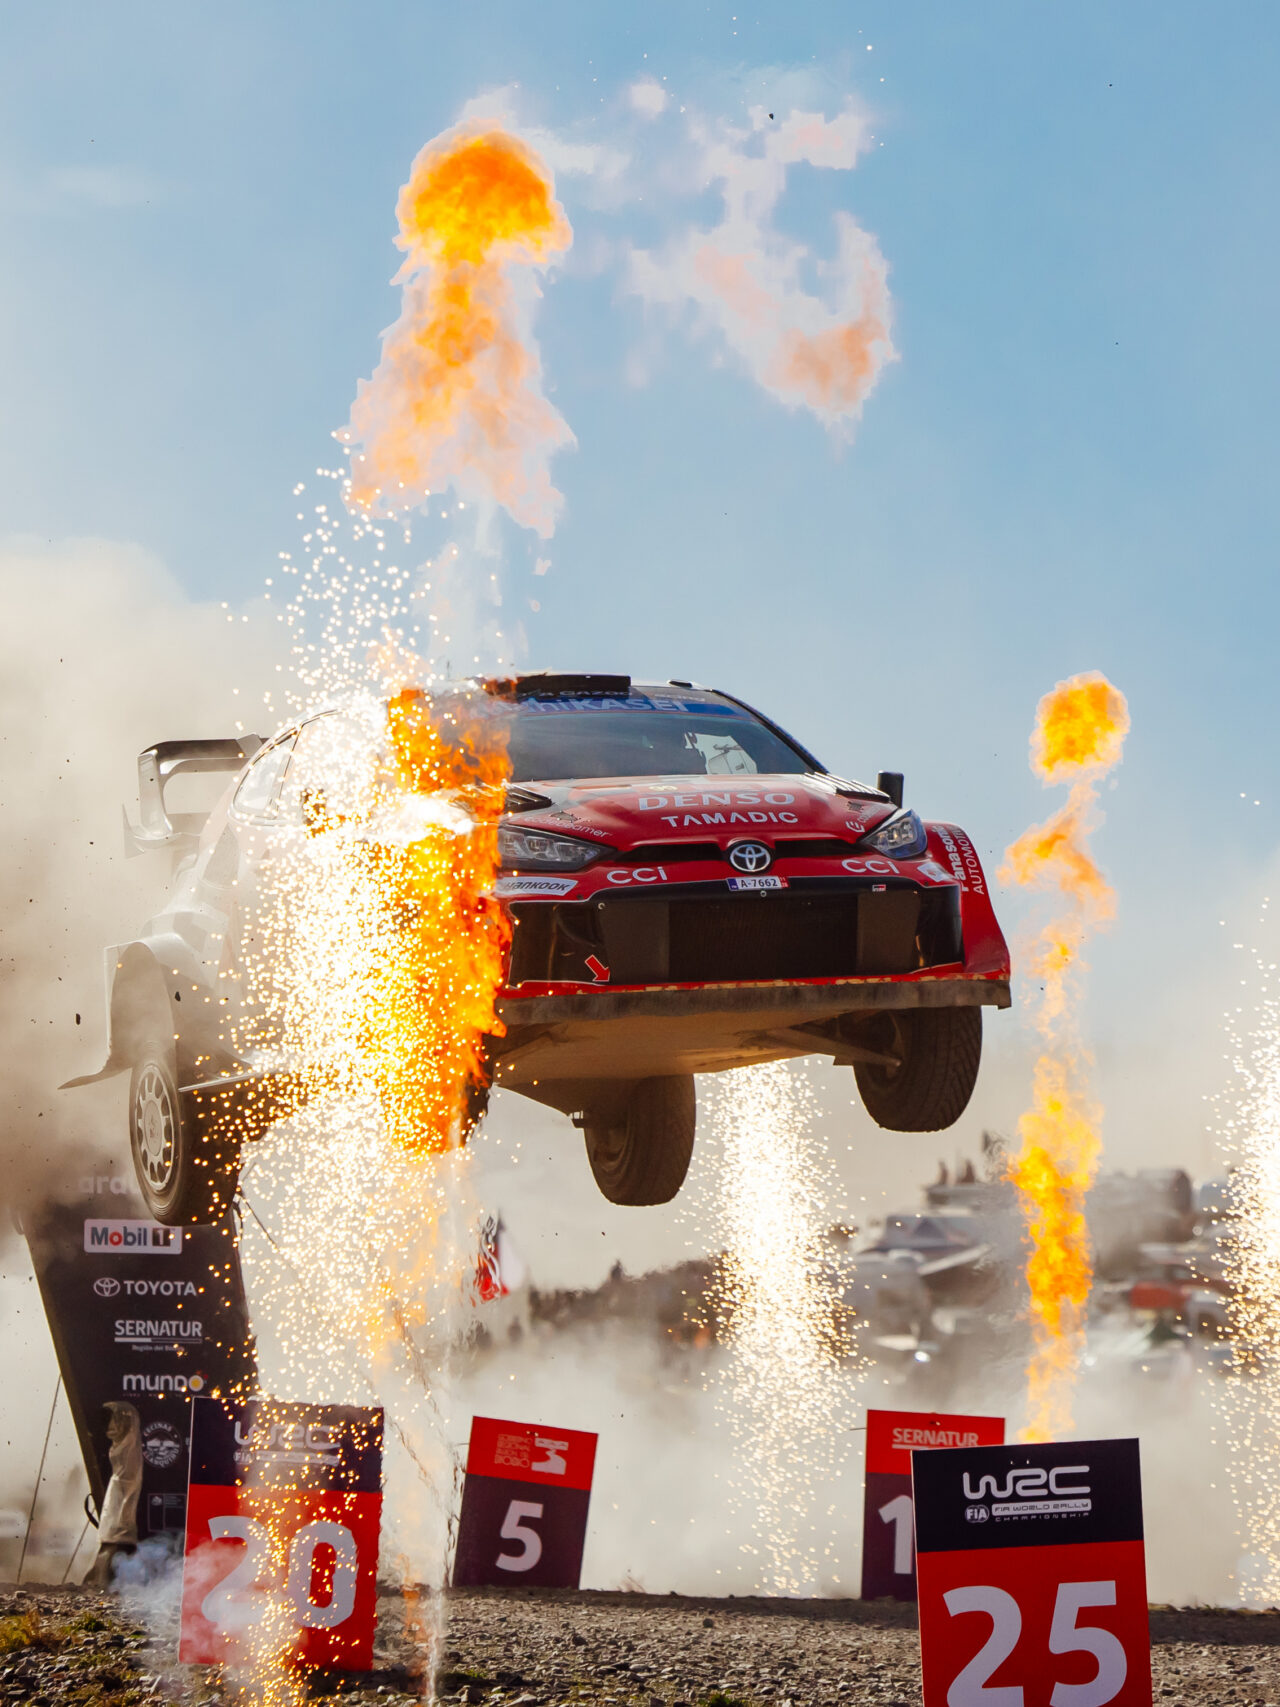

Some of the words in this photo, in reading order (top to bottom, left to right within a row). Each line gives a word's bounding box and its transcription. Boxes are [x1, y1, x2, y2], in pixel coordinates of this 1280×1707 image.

[639, 792, 795, 811] DENSO
[661, 811, 799, 828] TAMADIC
[607, 866, 668, 884] CCI
[841, 859, 900, 874] CCI
[741, 878, 778, 888] A-7662
[90, 1226, 147, 1246] Mobil
[124, 1281, 197, 1296] TOYOTA
[114, 1320, 202, 1337] SERNATUR
[892, 1427, 979, 1447] SERNATUR
[963, 1465, 1091, 1500] WRC
[966, 1507, 988, 1520] FIA
[495, 1500, 544, 1572] 5
[201, 1515, 360, 1630] 20
[943, 1580, 1128, 1707] 25
